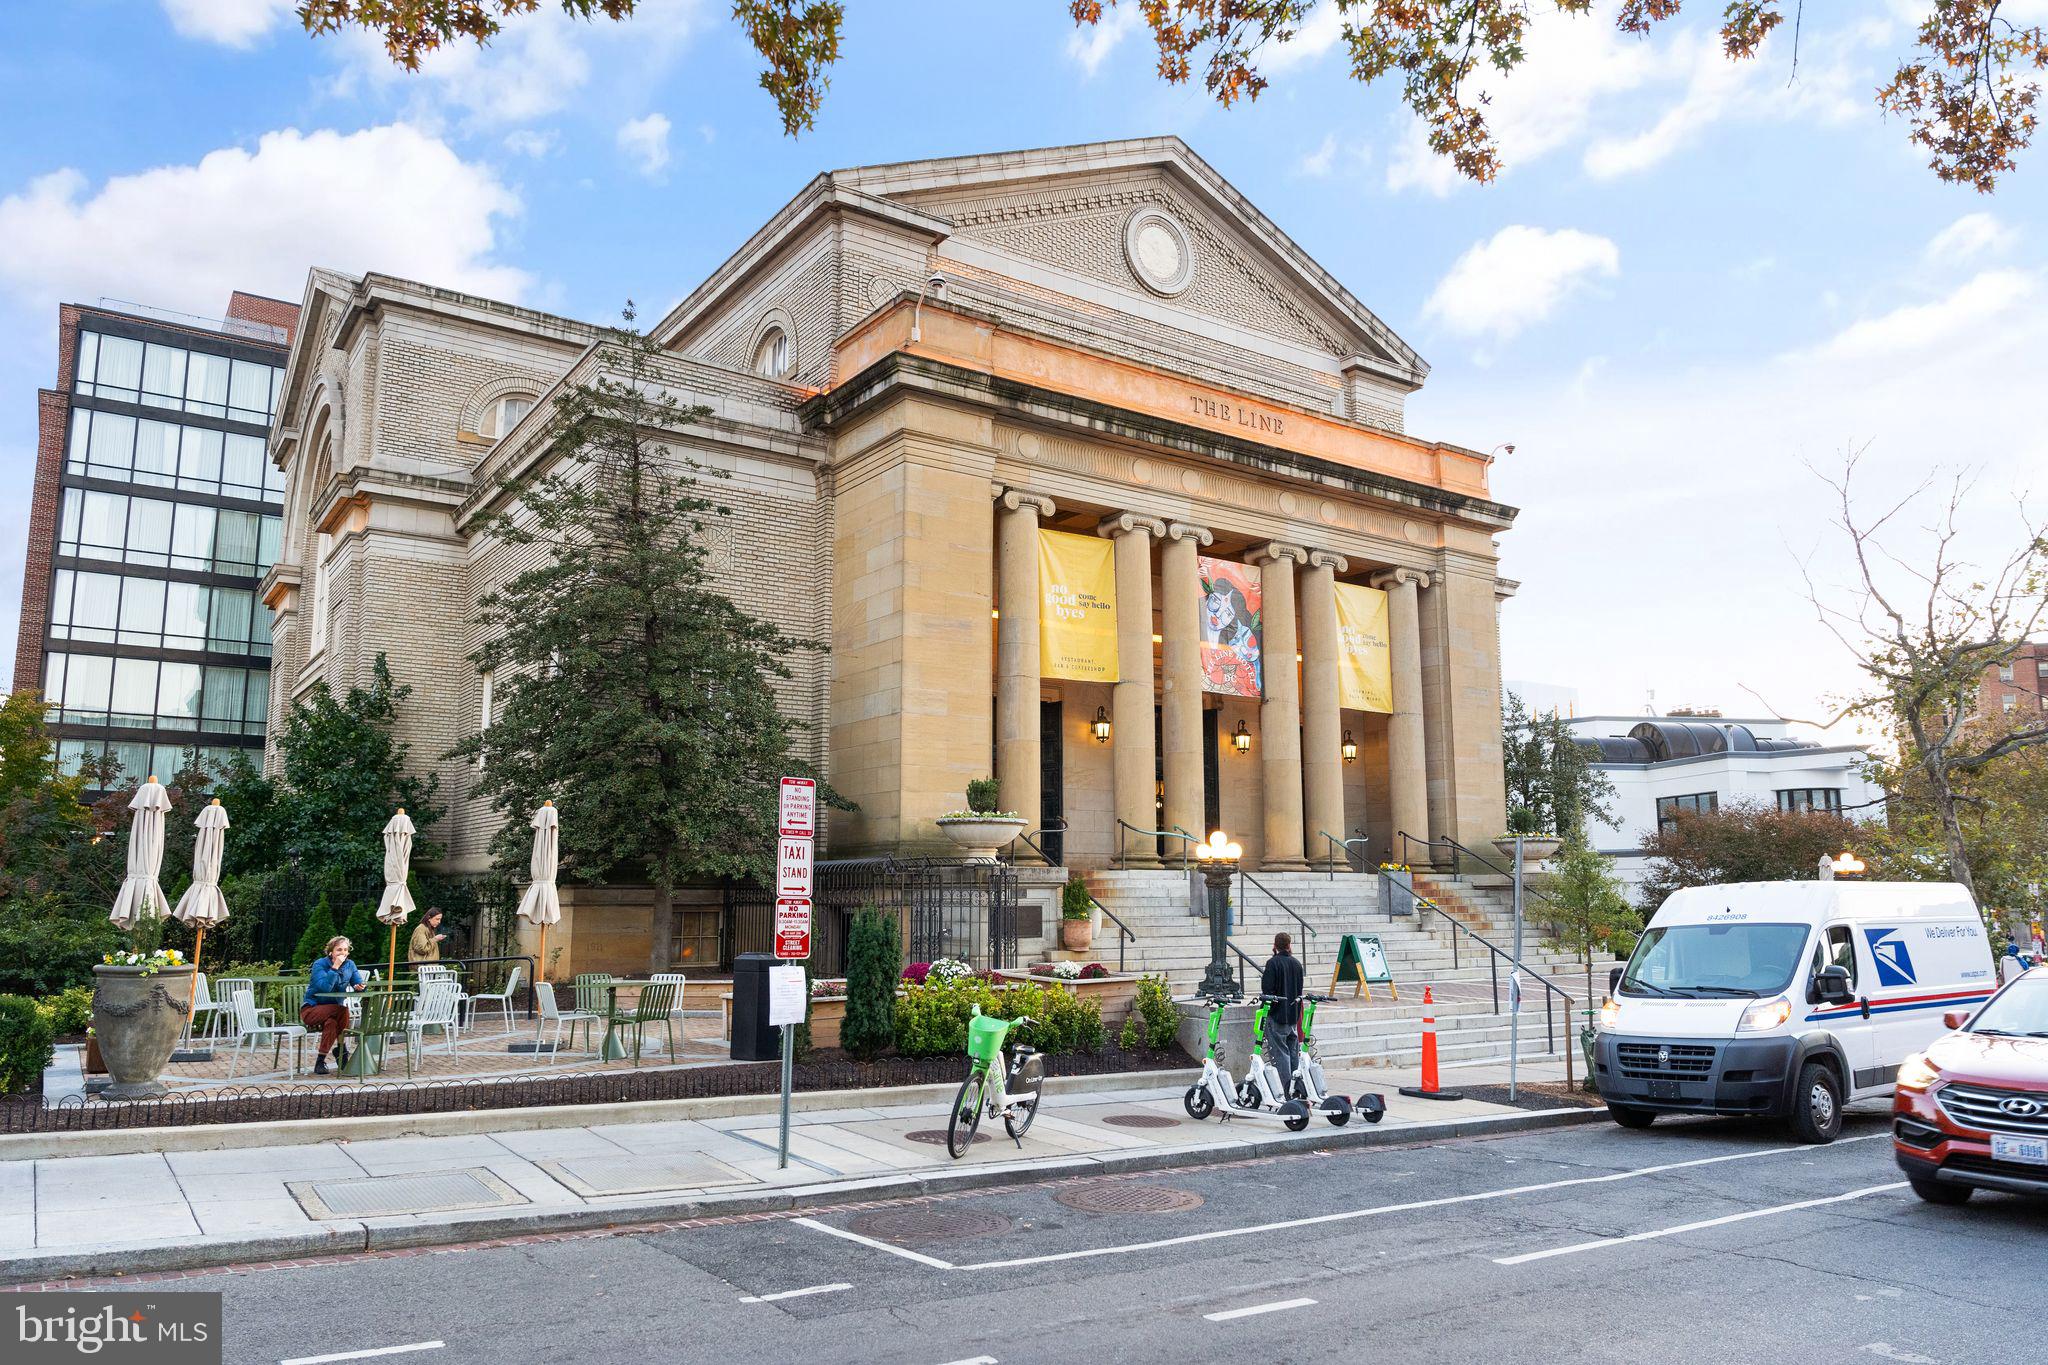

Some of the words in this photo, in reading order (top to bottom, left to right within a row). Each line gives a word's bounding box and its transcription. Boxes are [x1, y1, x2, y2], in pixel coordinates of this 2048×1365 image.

[1190, 396, 1230, 421] THE
[1238, 408, 1284, 435] LINE
[1052, 584, 1068, 594] no
[1045, 592, 1076, 608] good
[1078, 593, 1096, 601] come
[1091, 602, 1111, 610] hello
[1056, 605, 1085, 620] byes
[1215, 650, 1234, 660] LINE
[1224, 674, 1237, 682] DC
[786, 795, 810, 803] STANDING
[790, 803, 811, 811] PARKING
[784, 846, 805, 860] TAXI
[782, 866, 808, 879] STAND
[1925, 927, 1935, 938] We
[1935, 926, 1955, 938] Deliver
[1956, 926, 1965, 937] For
